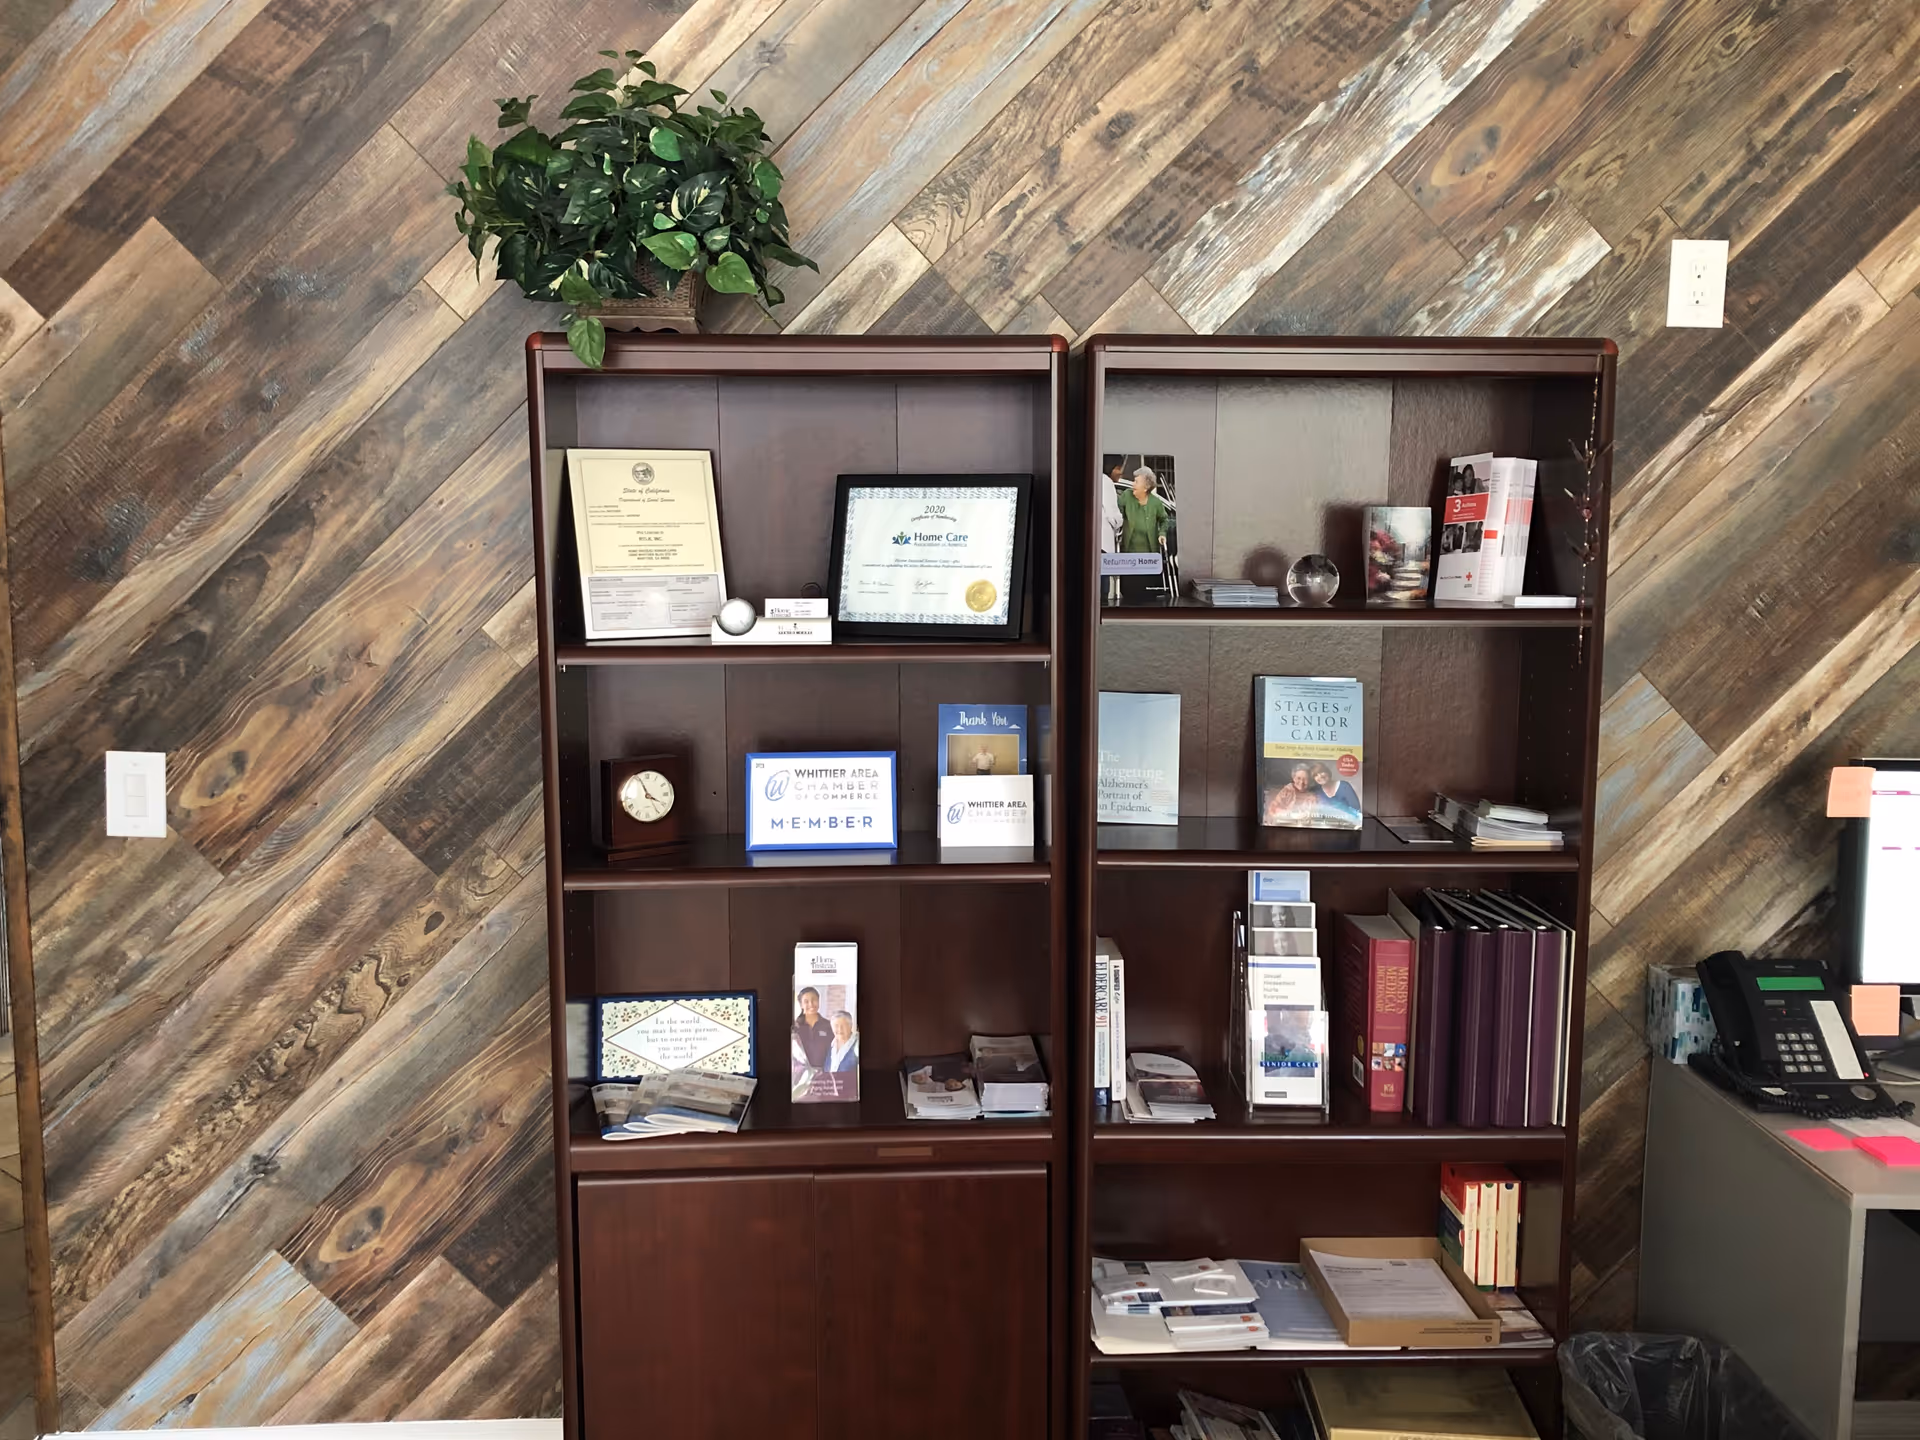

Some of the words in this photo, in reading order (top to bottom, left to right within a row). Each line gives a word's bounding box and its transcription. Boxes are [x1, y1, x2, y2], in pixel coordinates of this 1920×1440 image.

[924, 505, 946, 514] 2020
[1453, 499, 1462, 513] 3
[914, 532, 943, 541] Home
[946, 532, 968, 541] Care
[1103, 558, 1137, 567] Returning
[1274, 700, 1340, 713] STAGES
[1343, 704, 1353, 713] of
[958, 711, 988, 726] Thank
[991, 711, 1009, 726] You
[1280, 715, 1348, 728] SENIOR
[1291, 729, 1338, 741] CARE
[1099, 751, 1120, 762] The
[794, 769, 847, 778] WHITTIER
[850, 769, 879, 778] AREA
[794, 780, 879, 791] CHAMBER
[1098, 778, 1149, 789] Alzheimer's
[814, 792, 879, 800] COMMERCE
[1098, 789, 1130, 800] Portrait
[1132, 790, 1144, 800] of
[967, 809, 1028, 817] CHAMBER
[1110, 801, 1153, 814] Epidemic
[1095, 962, 1108, 1013] ELDERCARE
[1385, 965, 1397, 1013] MEDICAL
[1397, 965, 1409, 1015] MOSBY'S
[667, 1016, 677, 1025] the
[680, 1016, 700, 1024] world
[1095, 1015, 1108, 1028] 911
[646, 1035, 658, 1043] but
